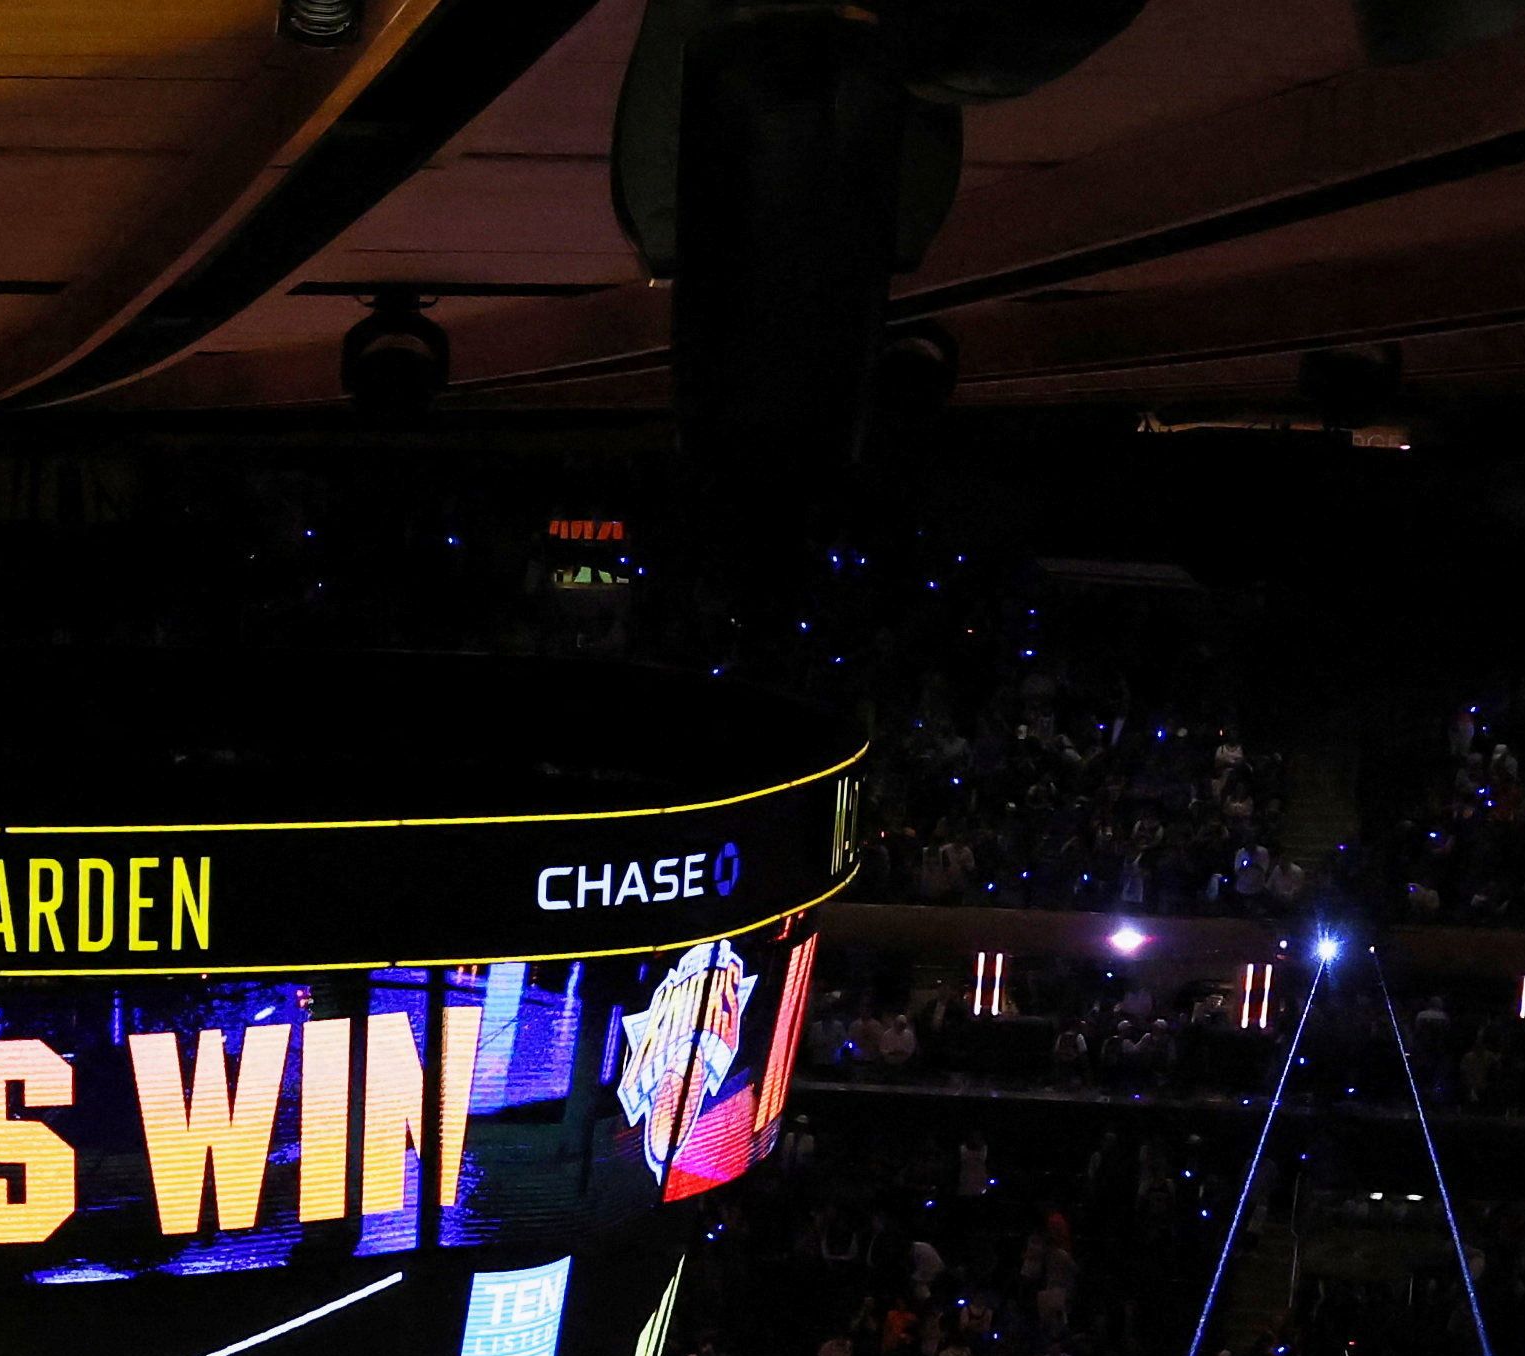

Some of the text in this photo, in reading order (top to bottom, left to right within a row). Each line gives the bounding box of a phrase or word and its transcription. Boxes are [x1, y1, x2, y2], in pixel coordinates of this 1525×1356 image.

[538, 854, 707, 910] CHASE
[129, 1010, 482, 1235] WIN
[484, 1271, 563, 1326] TEN
